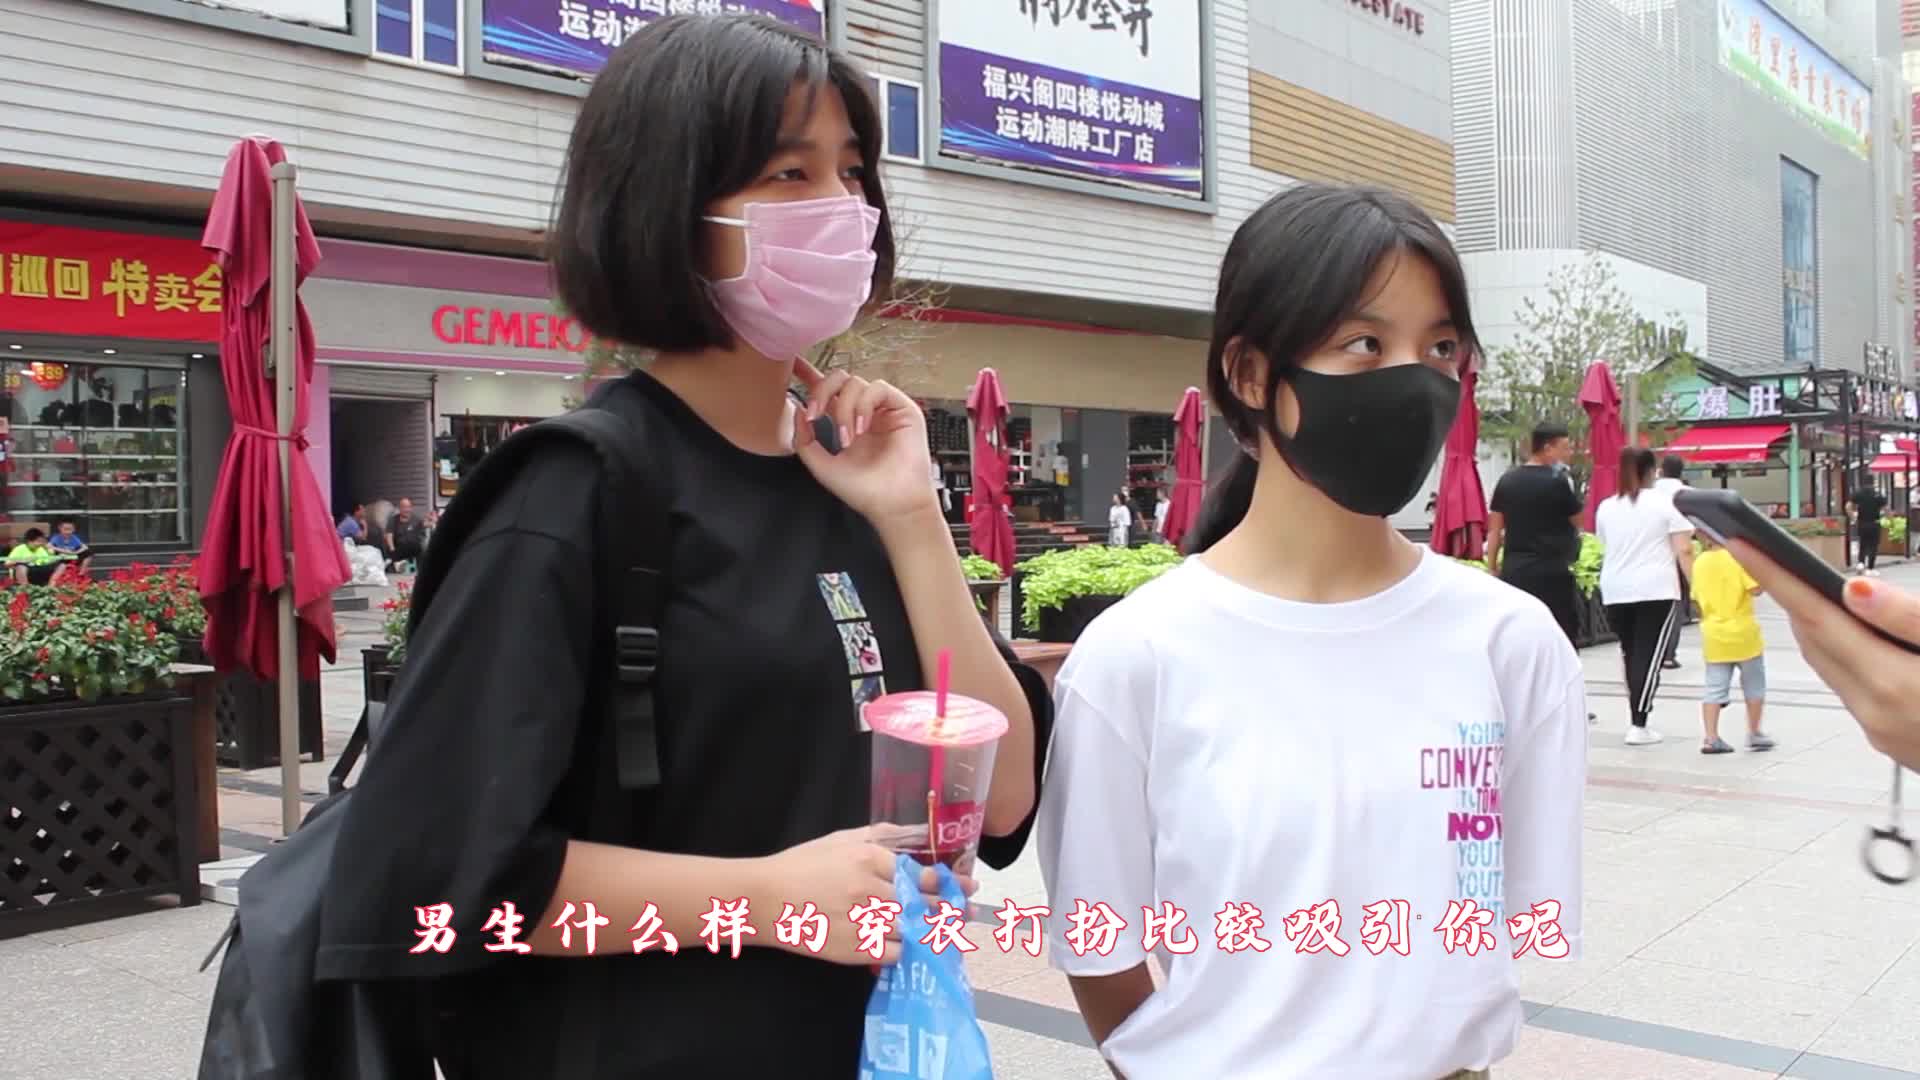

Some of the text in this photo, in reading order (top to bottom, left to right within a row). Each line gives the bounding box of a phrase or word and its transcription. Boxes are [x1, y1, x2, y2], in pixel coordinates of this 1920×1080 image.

[982, 64, 1166, 132] 福兴阁四楼悦动城
[996, 106, 1155, 164] 运动潮牌工厂店
[0, 253, 223, 317] 巡回特卖会
